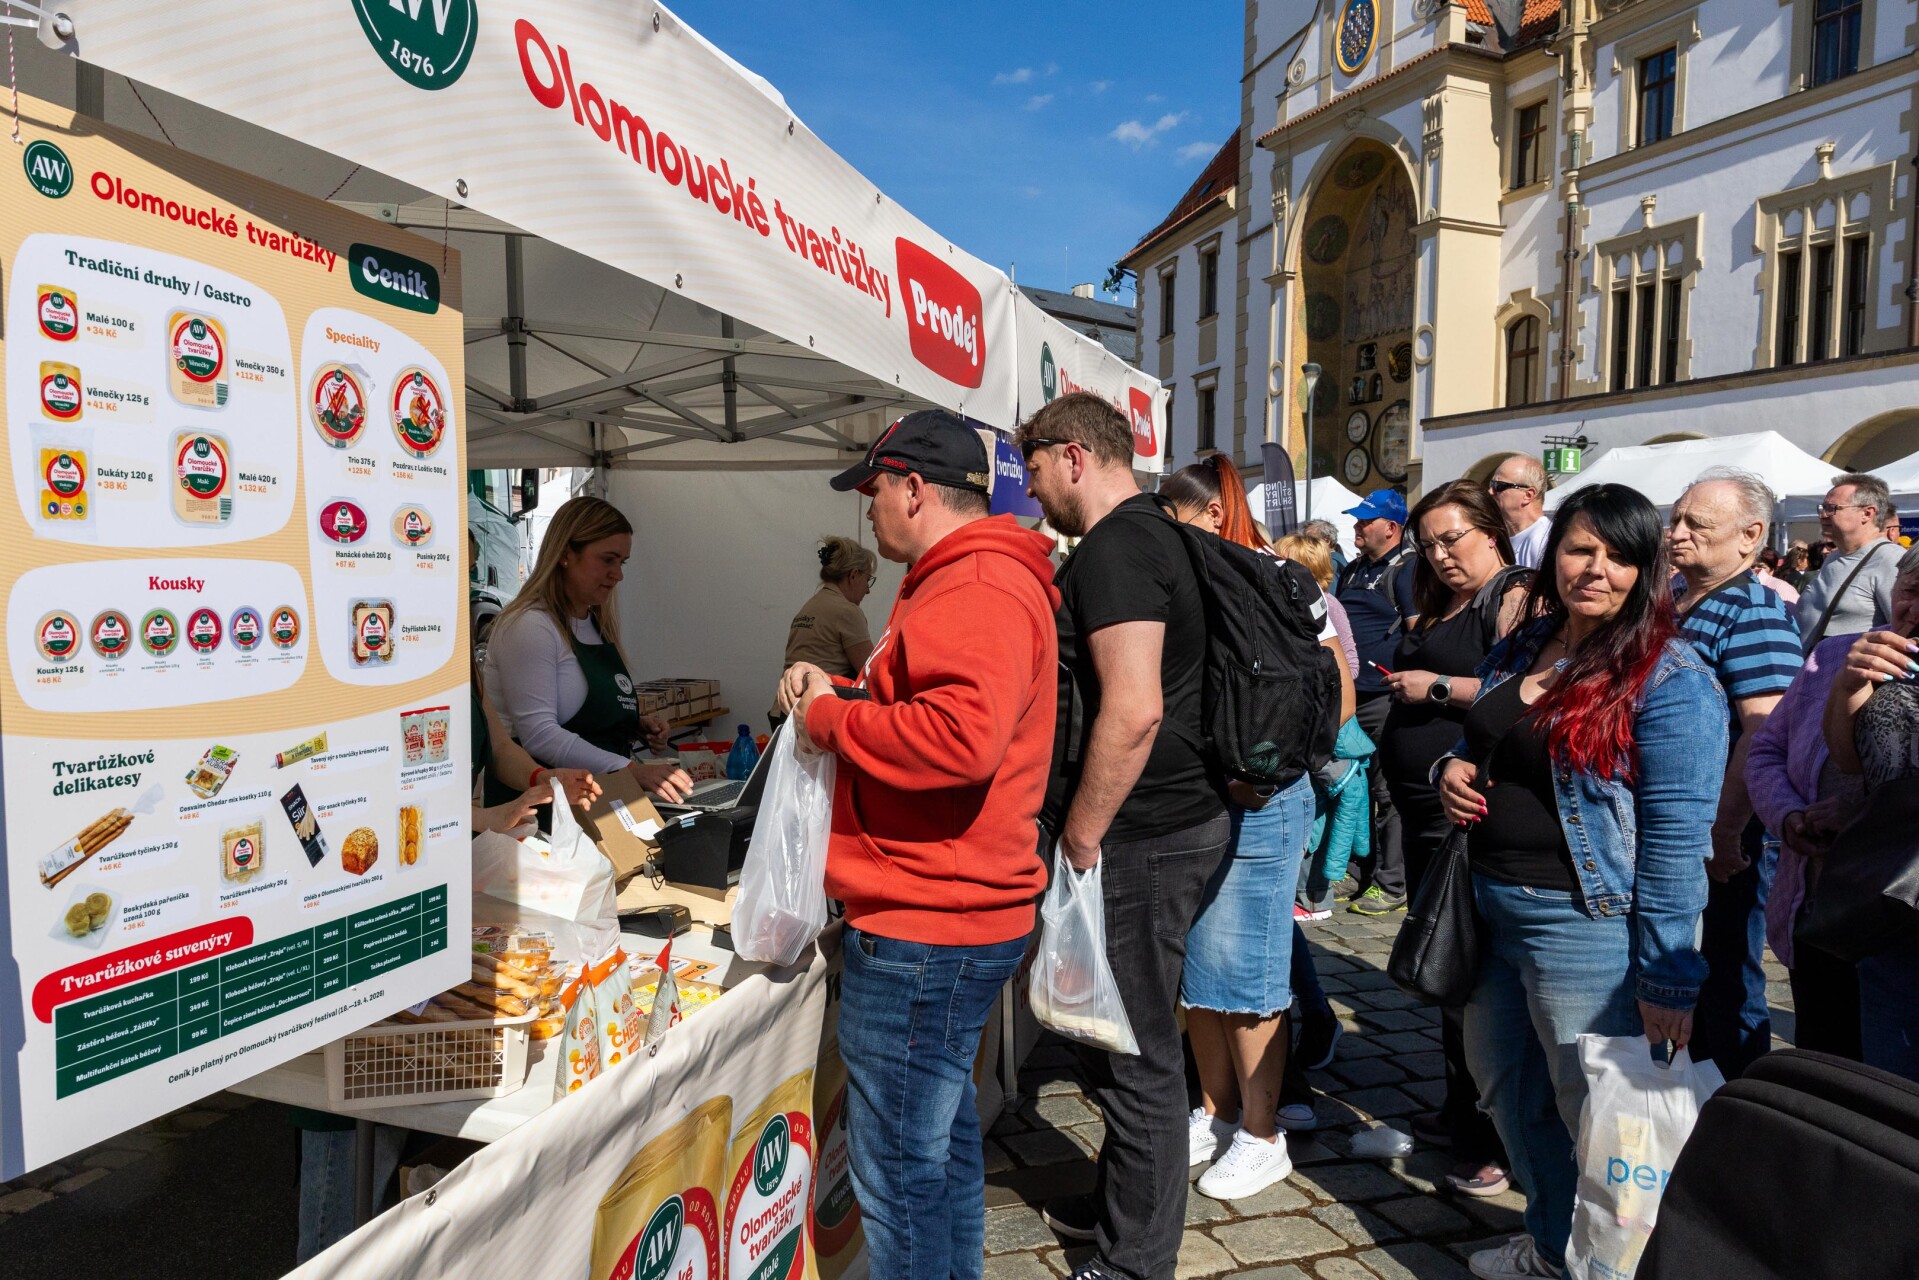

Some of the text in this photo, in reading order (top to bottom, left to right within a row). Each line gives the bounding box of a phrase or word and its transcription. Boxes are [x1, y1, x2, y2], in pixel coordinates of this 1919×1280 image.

[390, 40, 435, 77] 1876
[32, 154, 65, 184] AW
[514, 18, 891, 317] Olomoucké tvarůžky
[41, 185, 58, 196] 1876
[91, 171, 337, 272] Olomoucké tvarůžky
[65, 249, 140, 281] Tradiční
[144, 270, 190, 295] druhy
[203, 284, 251, 307] Gastro
[362, 254, 430, 300] Ceník
[86, 312, 135, 331] Malé 100 g
[910, 278, 977, 367] Prodej
[92, 327, 117, 338] 34 Kč
[325, 327, 381, 353] Speciality
[236, 359, 285, 377] Věnečky 350 g
[241, 372, 264, 382] 112 Kč
[1043, 360, 1054, 389] AW
[86, 387, 149, 405] Věnečky 125 g
[93, 401, 118, 412] 41 Kč
[1133, 408, 1152, 445] Prodej
[348, 456, 376, 468] Trio 375 g
[996, 454, 1023, 486] tvarůžky
[97, 468, 154, 482] Dukáty 120 g
[239, 473, 277, 485] Malé 420 g
[104, 481, 128, 491] 38 Kč
[258, 485, 267, 493] Kč
[335, 550, 361, 560] Hanácké
[376, 551, 387, 559] 200
[416, 553, 437, 562] Pusinky
[149, 576, 205, 593] Kousky
[37, 665, 85, 675] Kousky 125 g
[52, 676, 62, 684] Kč
[52, 749, 155, 777] Tvarůžkové
[52, 772, 142, 797] delikatesy
[228, 796, 239, 804] mix
[99, 841, 179, 864] Tvarůžkové tyčinky 130 g
[113, 861, 122, 870] Kč
[123, 891, 190, 915] Beskydská pařenička
[123, 908, 161, 924] uzená 100 g
[137, 921, 145, 929] Kč
[60, 931, 233, 993] Tvarůžkové suvenýry
[225, 960, 249, 972] Klobouk
[189, 972, 209, 985] 199 Kč
[225, 987, 248, 1000] Klobouk
[83, 991, 155, 1020] Tvarůžková kuchařka
[201, 999, 210, 1008] Kč
[223, 1016, 243, 1027] Čepice
[77, 1027, 129, 1052] Zástěra béžová
[191, 1027, 208, 1039] 99 Kč
[168, 1007, 338, 1084] Ceník je platný pro Olomoucký tvarůžkový festival
[76, 1045, 163, 1083] Multifunkční šátek béžový
[794, 1123, 804, 1134] OD
[759, 1130, 785, 1179] AW
[765, 1177, 779, 1192] 1876
[689, 1200, 700, 1213] OD
[701, 1207, 715, 1241] ROKU
[740, 1174, 802, 1261] Olomoucké tvarůžky
[642, 1213, 679, 1276] AW
